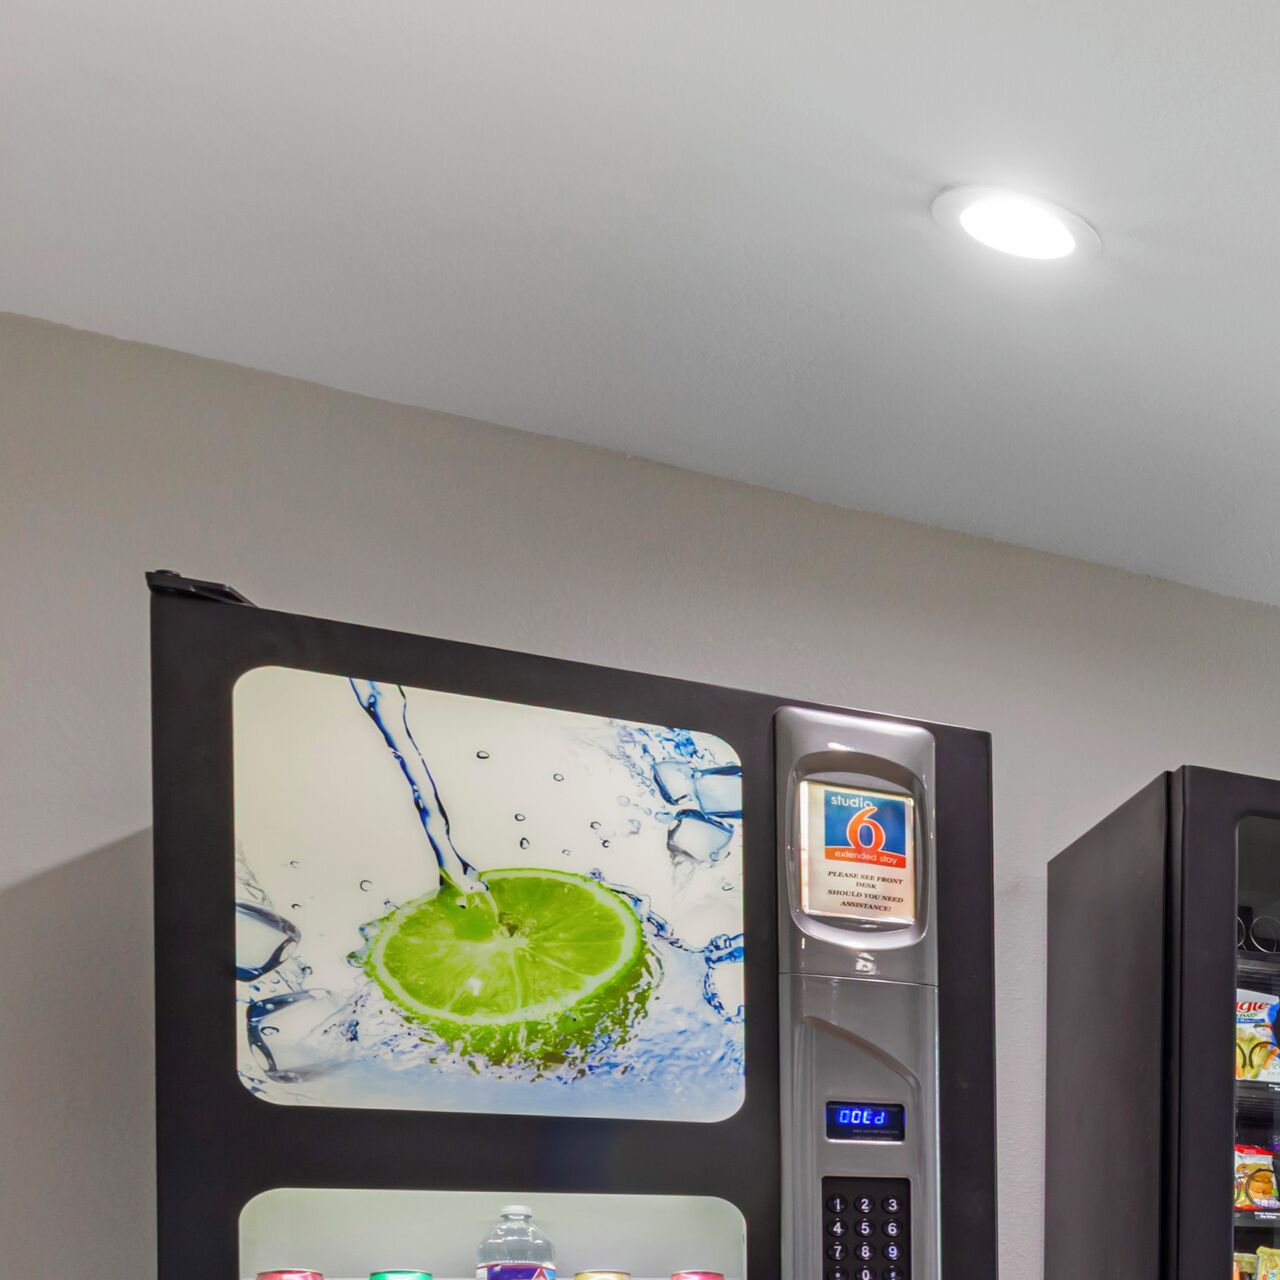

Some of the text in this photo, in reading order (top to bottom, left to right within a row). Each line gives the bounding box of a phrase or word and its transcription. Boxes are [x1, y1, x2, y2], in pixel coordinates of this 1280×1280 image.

[831, 795, 873, 808] studio
[846, 806, 885, 852] 6
[835, 851, 898, 865] extended stay
[828, 871, 859, 879] PLEASE
[876, 876, 904, 885] FRONT
[827, 889, 862, 898] SHOULD
[840, 901, 891, 912] ASSISTANCE!
[835, 1199, 897, 1211] 1 2 3
[833, 1223, 897, 1234] 4 5 6
[834, 1246, 897, 1257] 7 8 9
[862, 1269, 870, 1280] 0
